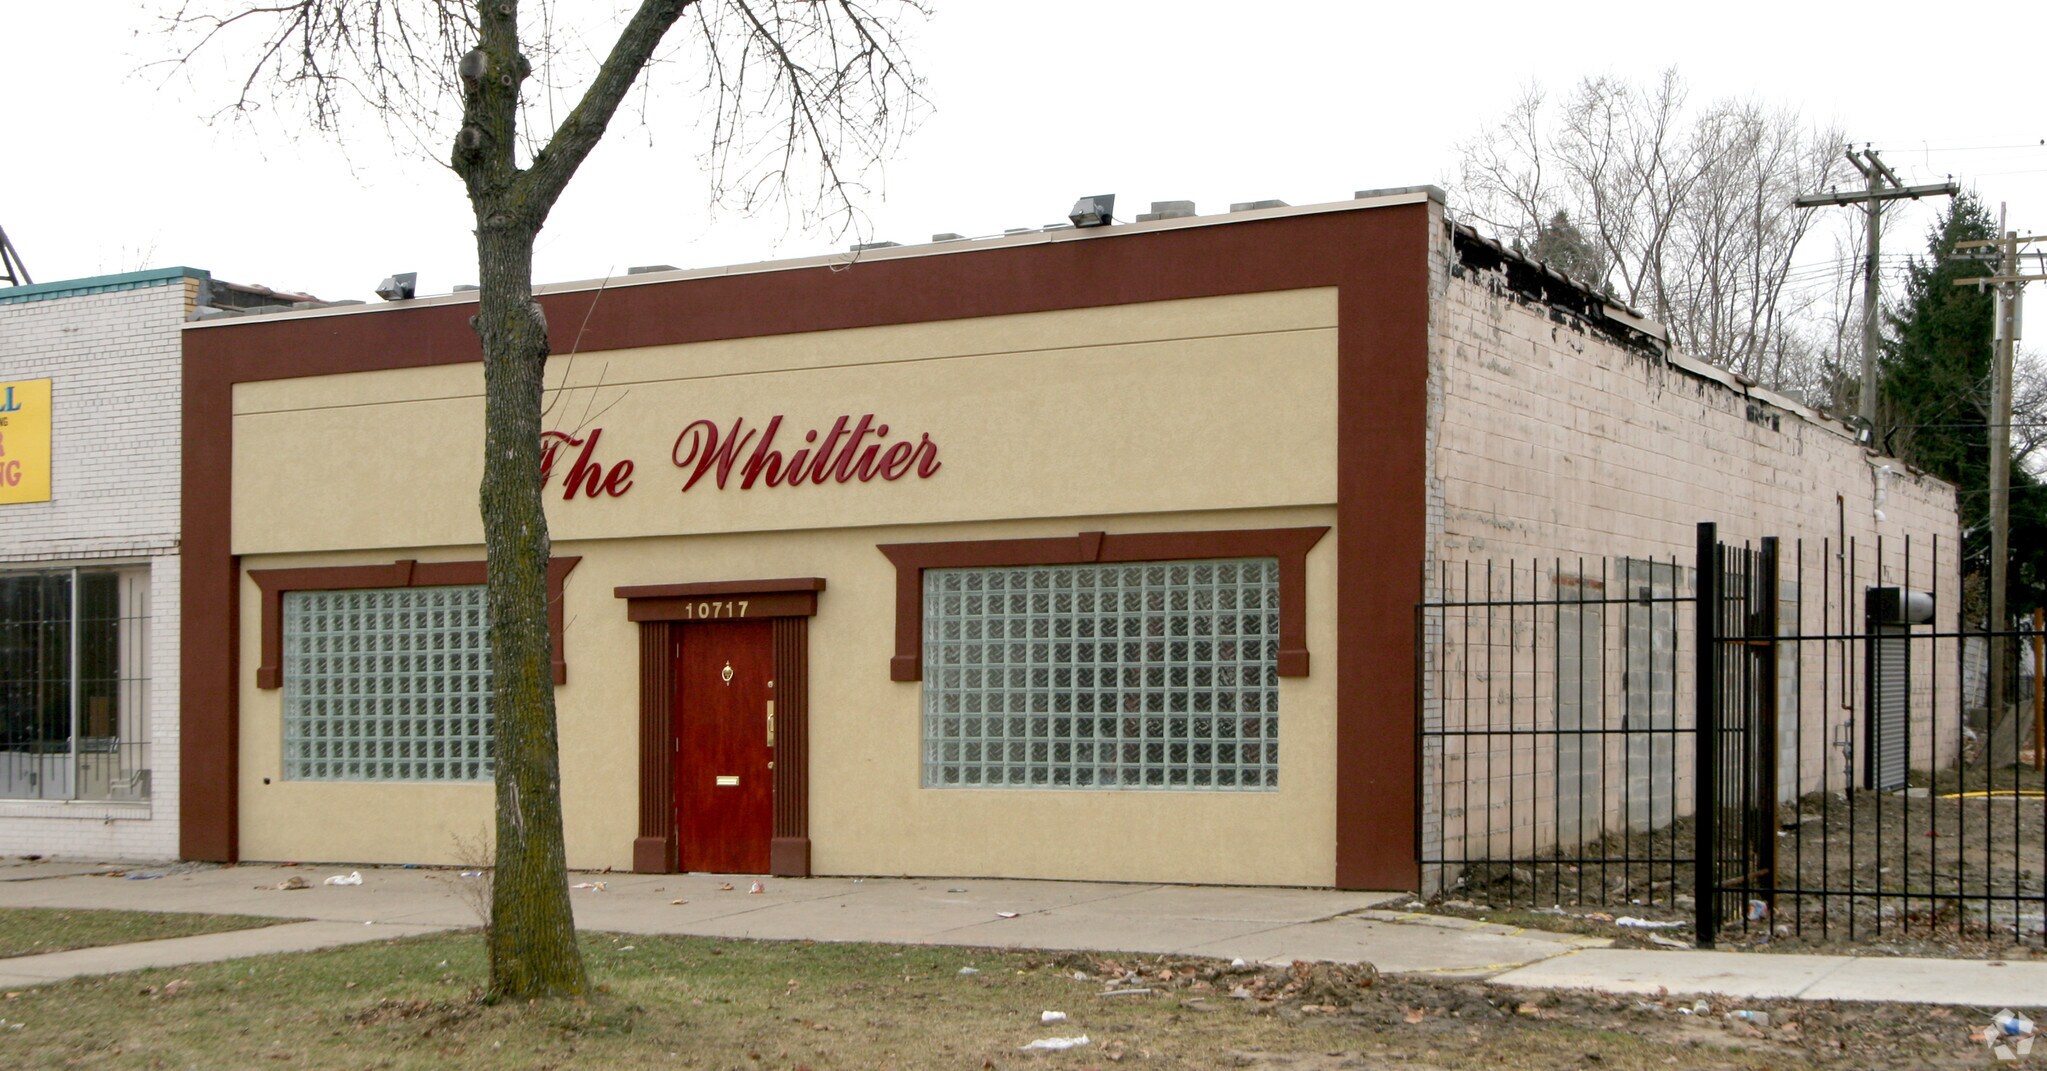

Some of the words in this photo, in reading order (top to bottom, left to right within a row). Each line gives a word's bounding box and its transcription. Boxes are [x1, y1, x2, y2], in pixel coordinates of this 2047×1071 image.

[540, 428, 634, 500] The
[672, 414, 942, 492] Whittier
[685, 601, 749, 619] 10717
